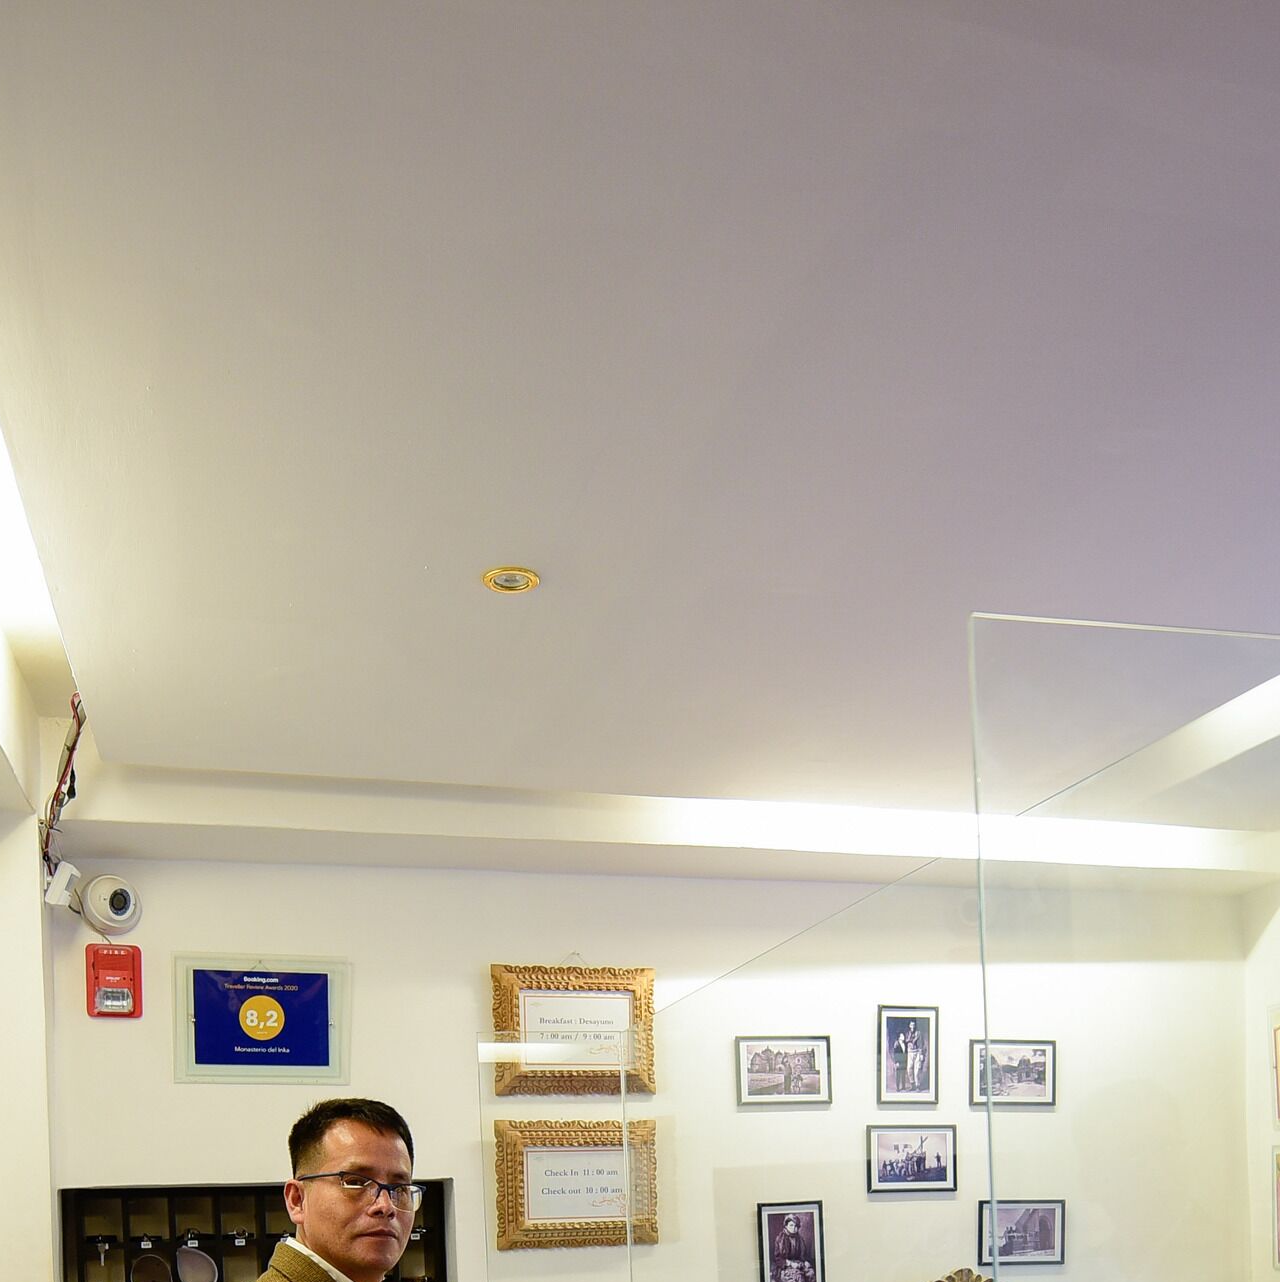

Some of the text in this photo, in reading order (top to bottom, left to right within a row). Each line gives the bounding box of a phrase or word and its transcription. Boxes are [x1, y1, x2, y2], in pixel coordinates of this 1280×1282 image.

[246, 1009, 278, 1029] 8,2
[539, 1017, 573, 1025] Breakfast
[579, 1017, 614, 1026] Desayuno
[544, 1169, 569, 1177] Check
[570, 1169, 579, 1177] In
[541, 1187, 566, 1195] Check
